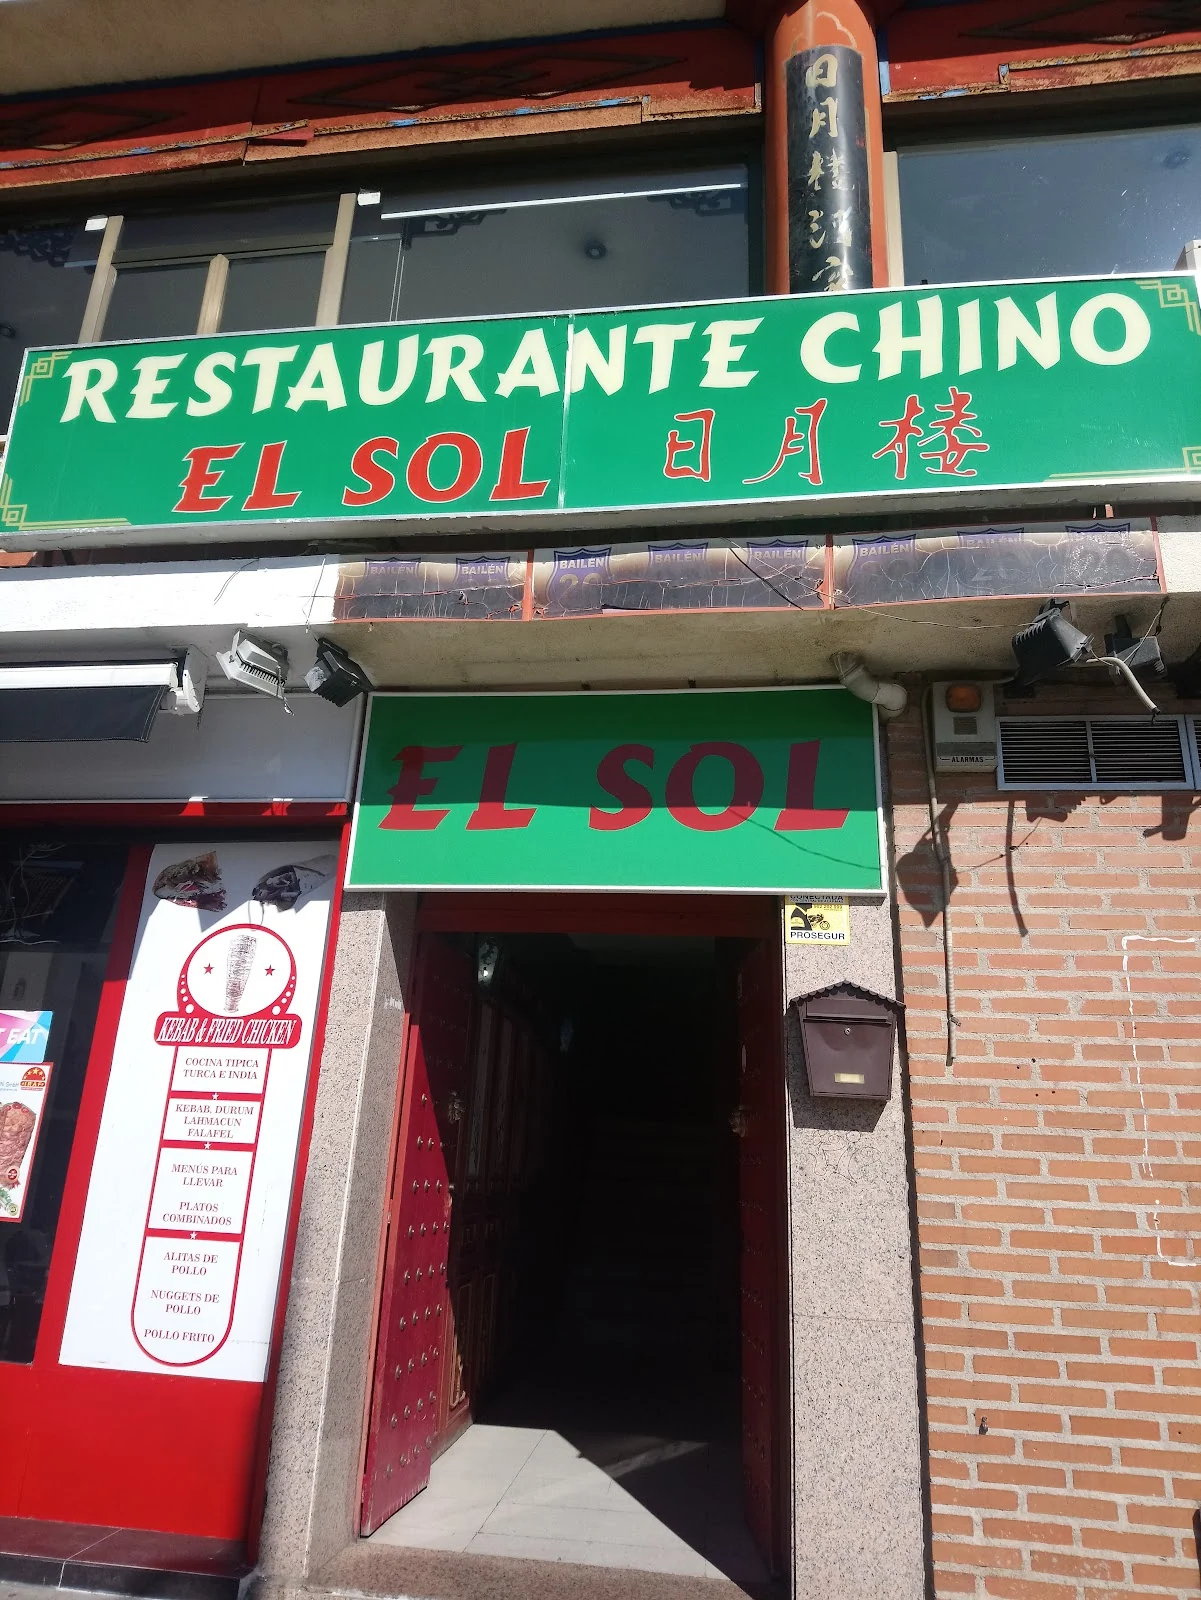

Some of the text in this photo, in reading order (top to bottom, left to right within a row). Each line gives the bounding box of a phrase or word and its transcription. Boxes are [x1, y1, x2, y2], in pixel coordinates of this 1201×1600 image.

[60, 291, 1151, 423] RESTAURANTE CHINO
[172, 425, 552, 513] EL SOL
[754, 548, 801, 560] BAILÉN
[860, 541, 910, 557] BAILÉN
[560, 556, 605, 570] BAILÉN
[655, 551, 701, 563] BAILÉN
[461, 562, 504, 575] BAILÉN
[951, 755, 984, 763] ALARMAS
[377, 739, 851, 832] EL SOL
[790, 931, 845, 940] PROSEGUR
[6, 1028, 44, 1045] EAT
[156, 1017, 199, 1043] KEBAB
[204, 1018, 244, 1044] FRIED
[241, 1019, 297, 1045] CHICKEN
[185, 1058, 259, 1068] COCINA TIPICA
[183, 1069, 258, 1080] TURCA E INDIA
[215, 1105, 254, 1115] DURUM
[183, 1116, 242, 1126] LAHMACUN
[187, 1128, 234, 1139] FALAFEL
[171, 1163, 238, 1176] MENÚS PARA
[182, 1177, 223, 1187] LLEVAR
[179, 1201, 219, 1212] PLATOS
[162, 1213, 232, 1226] COMBINADOS
[163, 1252, 218, 1264] ALITAS DE
[171, 1265, 207, 1276] POLLO
[150, 1289, 220, 1304] NUGGETS DE
[165, 1304, 201, 1315] POLLO
[144, 1329, 215, 1343] POLLO FRITO
